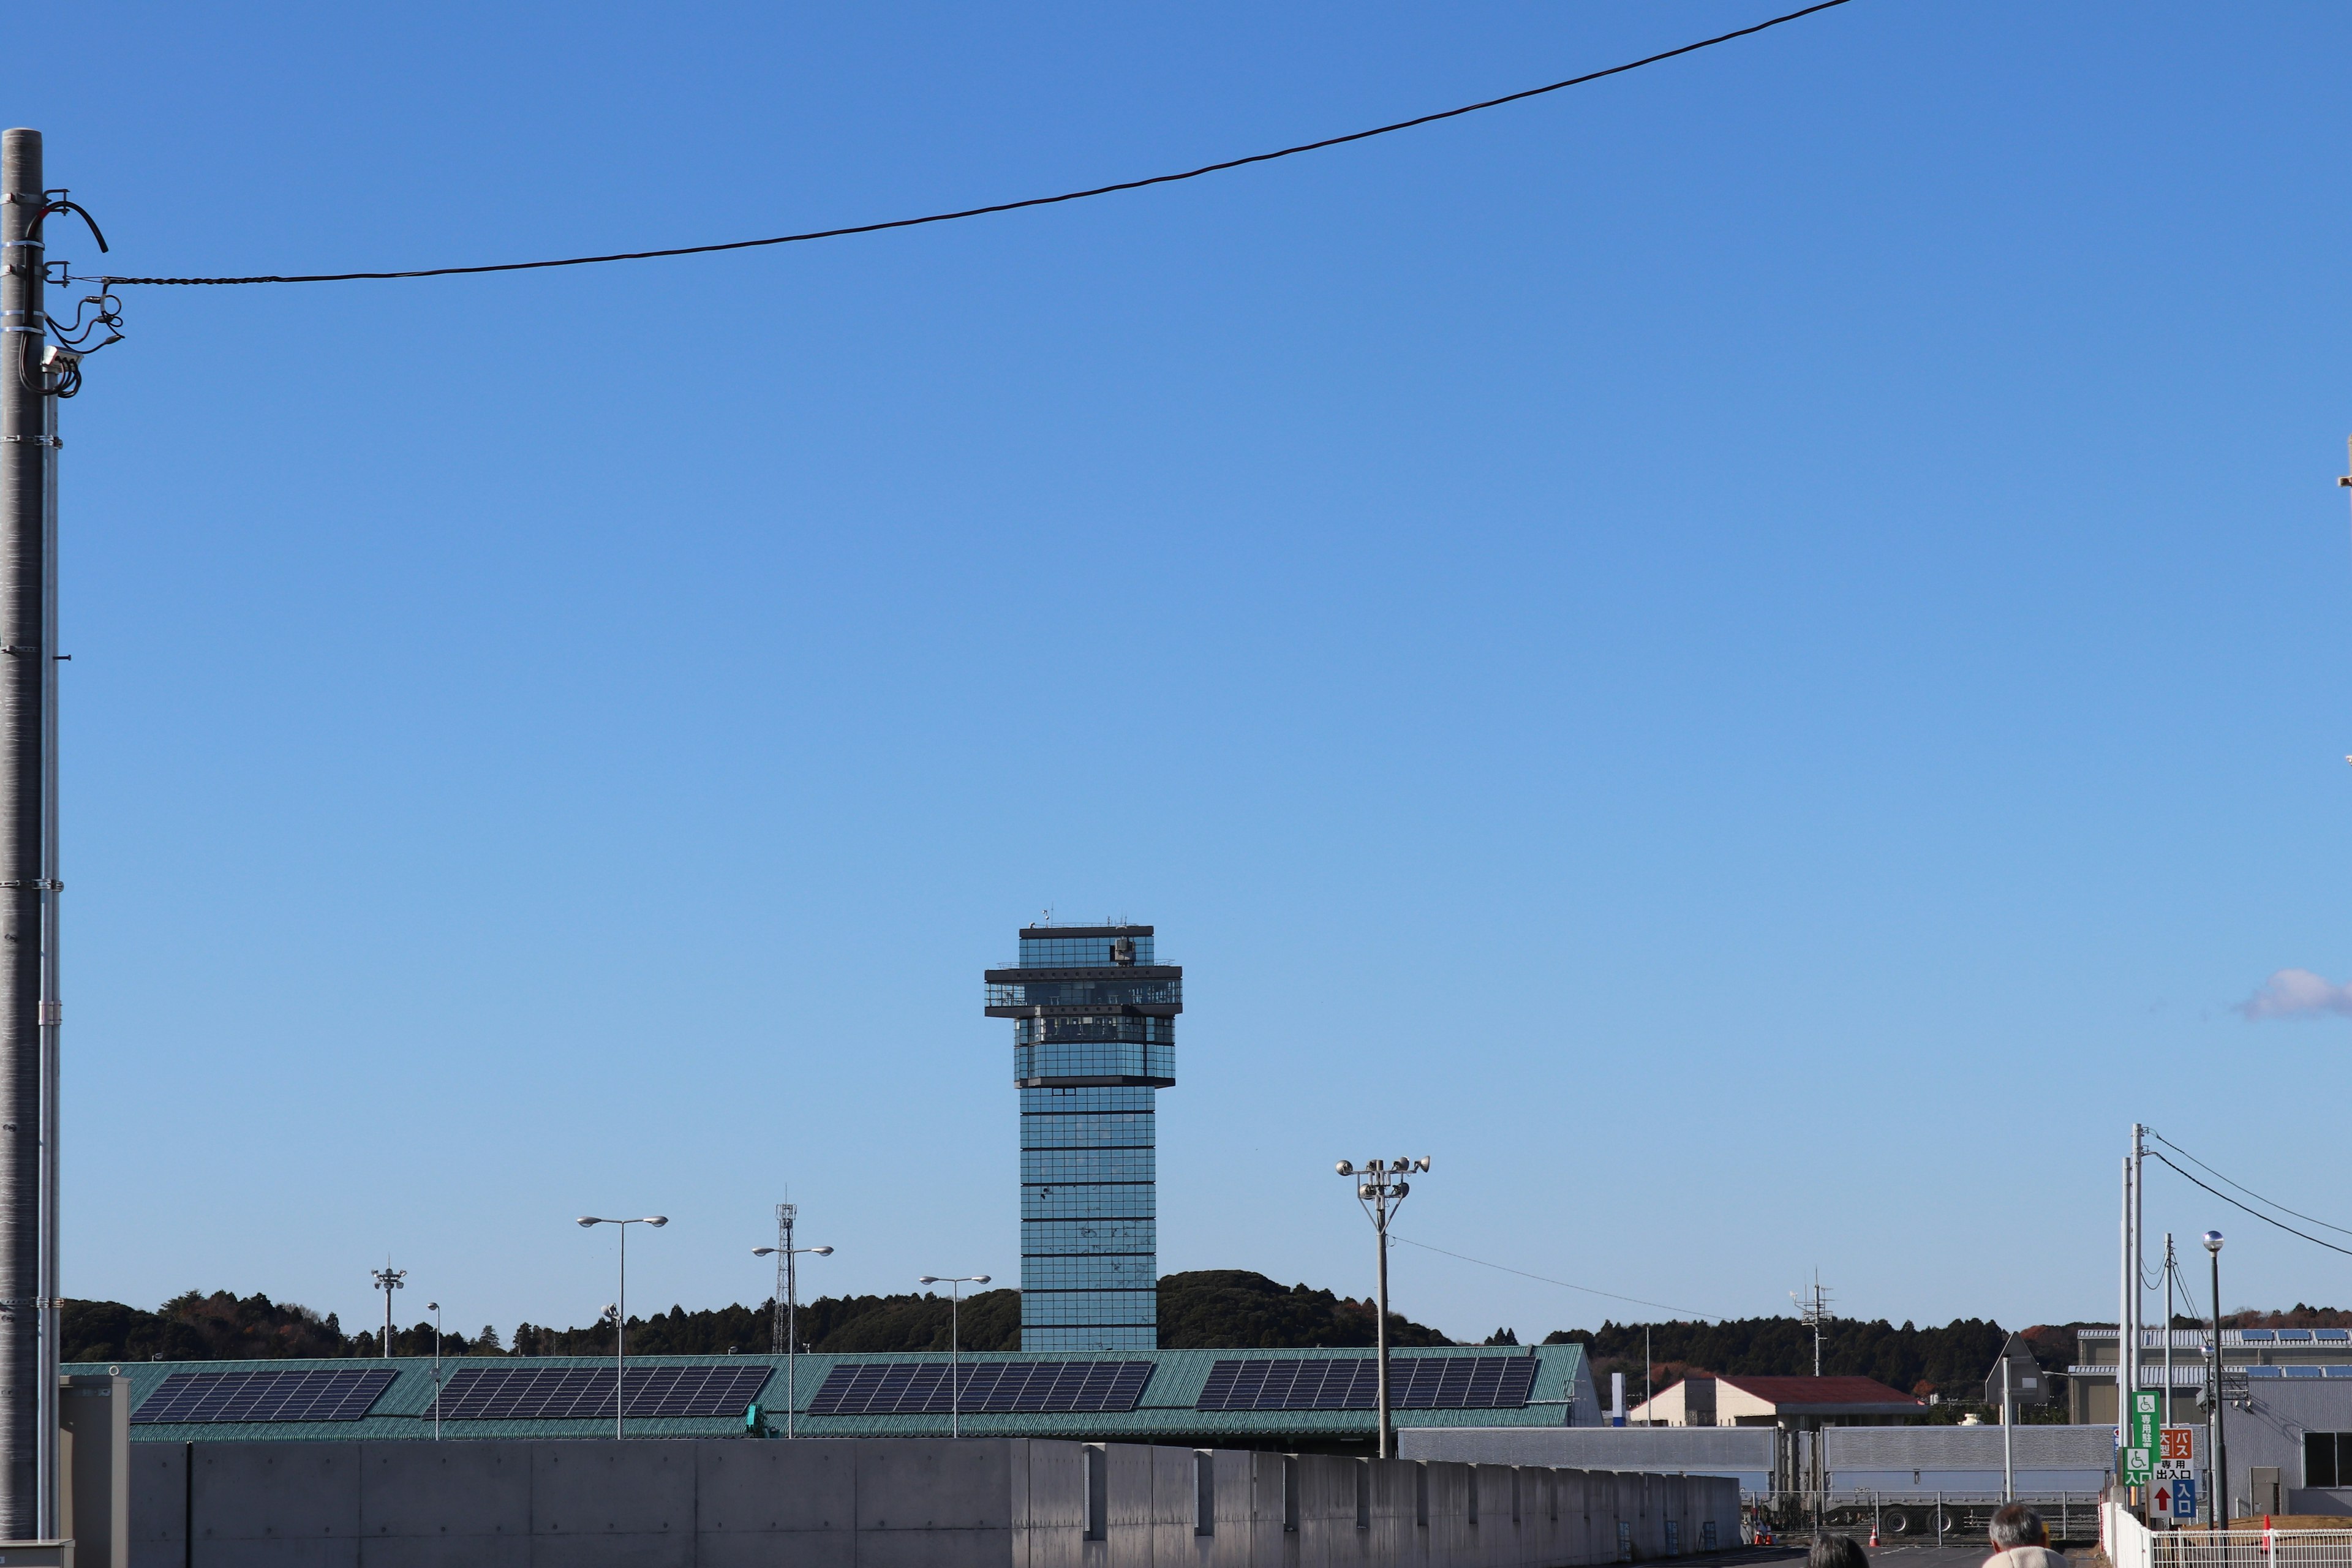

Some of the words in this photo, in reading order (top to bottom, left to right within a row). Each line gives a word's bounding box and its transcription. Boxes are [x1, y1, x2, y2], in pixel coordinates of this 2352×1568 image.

[2160, 1433, 2170, 1457] 大型
[2176, 1433, 2188, 1457] バス
[2162, 1460, 2185, 1469] 専用
[2125, 1472, 2152, 1485] 入口
[2157, 1470, 2191, 1480] 出入口
[2178, 1483, 2191, 1514] 入口
